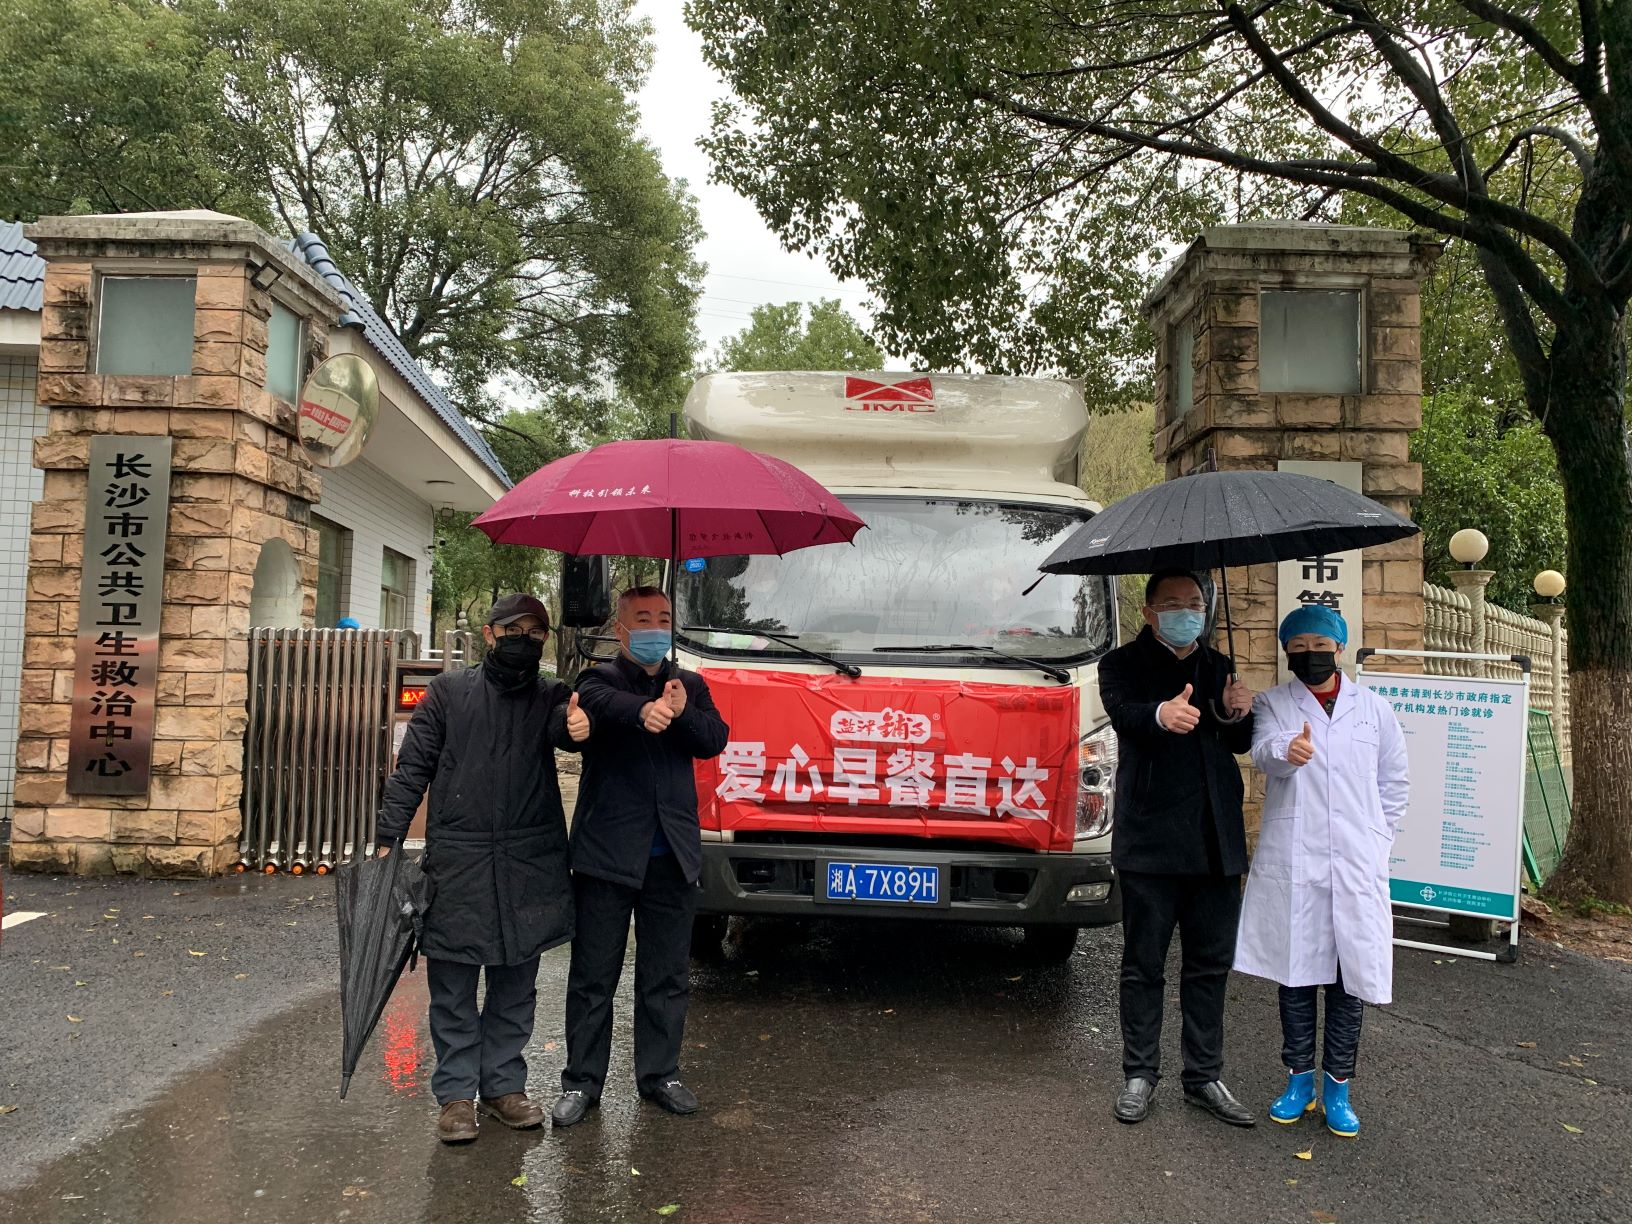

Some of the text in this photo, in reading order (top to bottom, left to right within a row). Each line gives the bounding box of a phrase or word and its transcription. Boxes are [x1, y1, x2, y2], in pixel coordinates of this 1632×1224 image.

[844, 403, 936, 413] JMC
[85, 452, 152, 777] 长沙市公共卫生救治中心
[1368, 685, 1512, 705] 发热患者请到长沙市政府指定
[1388, 701, 1494, 719] 疗机构发热门诊就诊
[836, 711, 929, 740] 盐津铺子
[715, 741, 1050, 821] 爱心早餐直达
